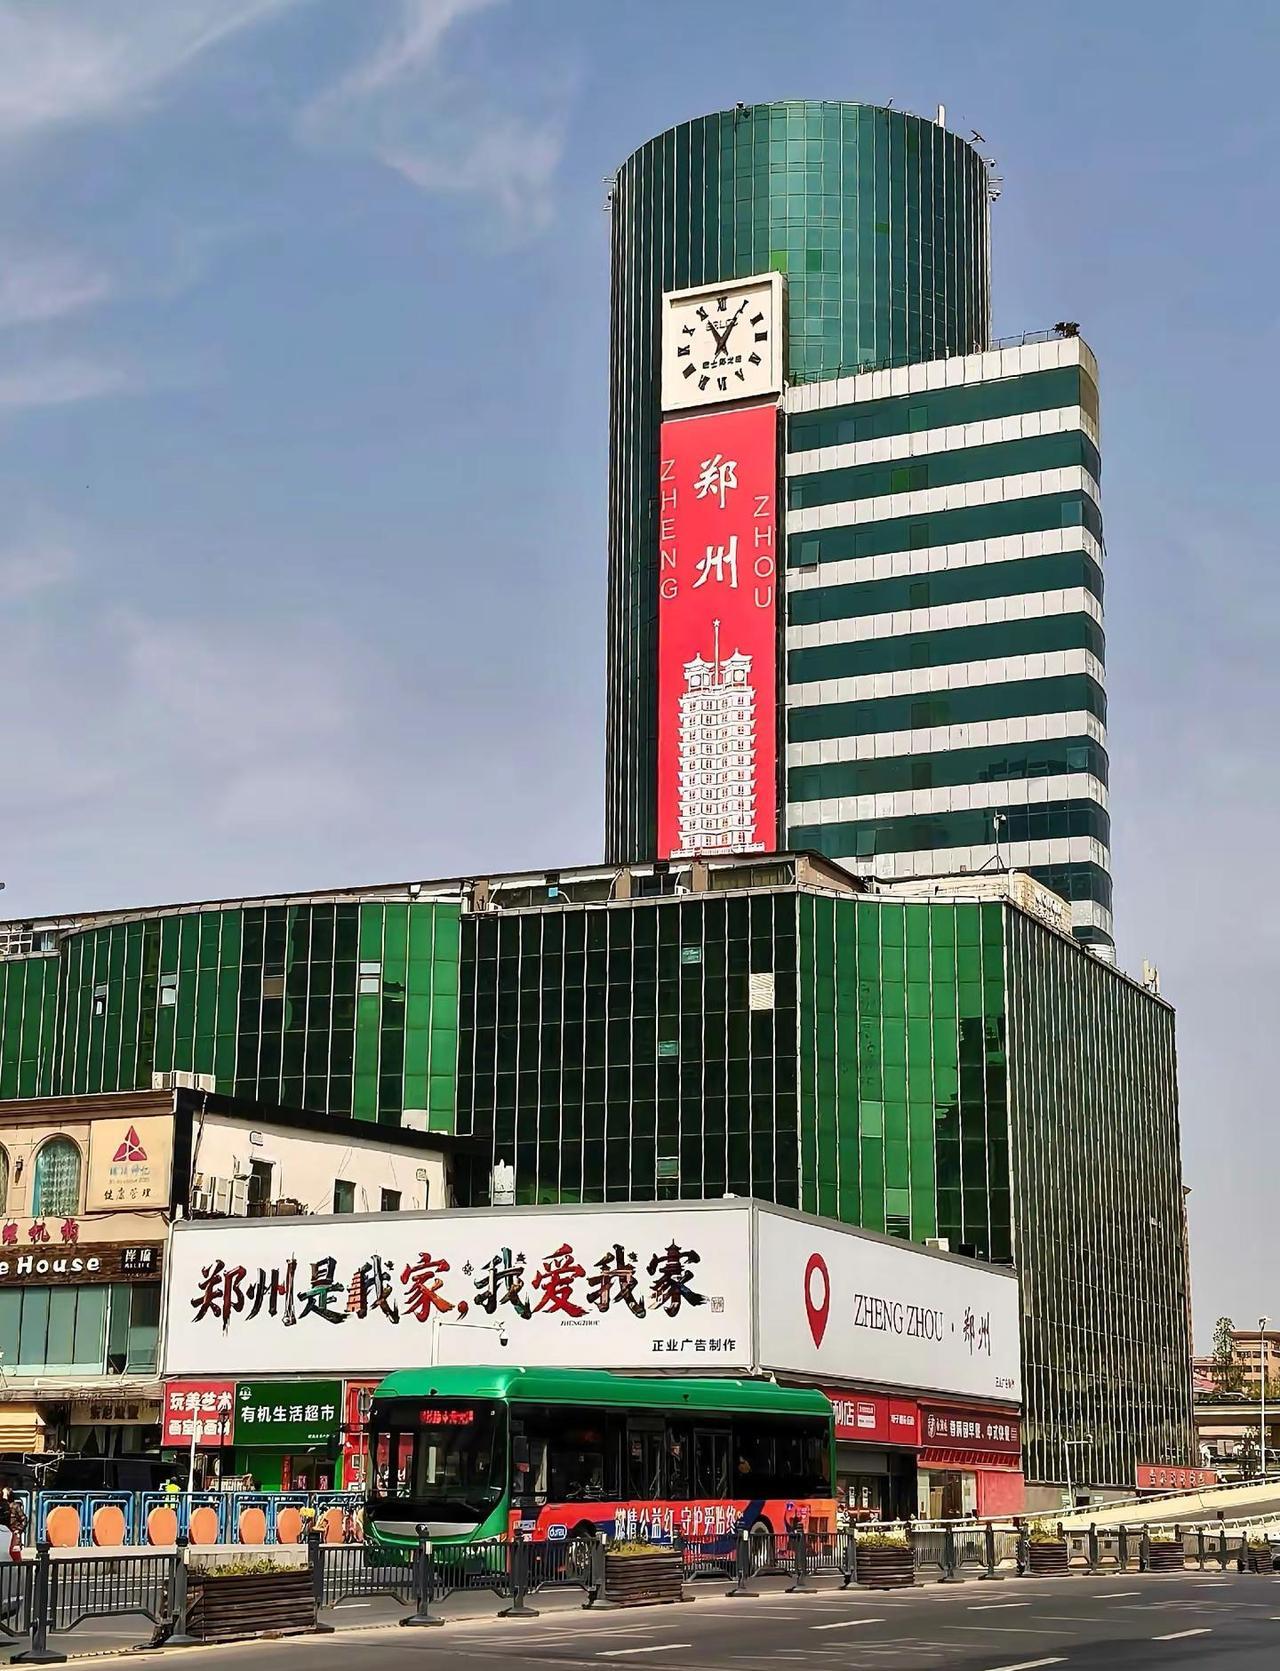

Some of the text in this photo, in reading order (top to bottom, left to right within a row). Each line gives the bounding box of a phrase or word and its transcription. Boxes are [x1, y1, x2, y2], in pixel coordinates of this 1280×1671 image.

[660, 459, 678, 599] ZHENG
[692, 454, 738, 588] 郑州
[753, 495, 774, 608] ZHOU
[17, 1255, 100, 1275] House
[652, 1338, 736, 1352] 正业广告制作
[853, 1294, 991, 1357] ZHENG ZHOU 郑州
[241, 1404, 335, 1423] 有机生活超市
